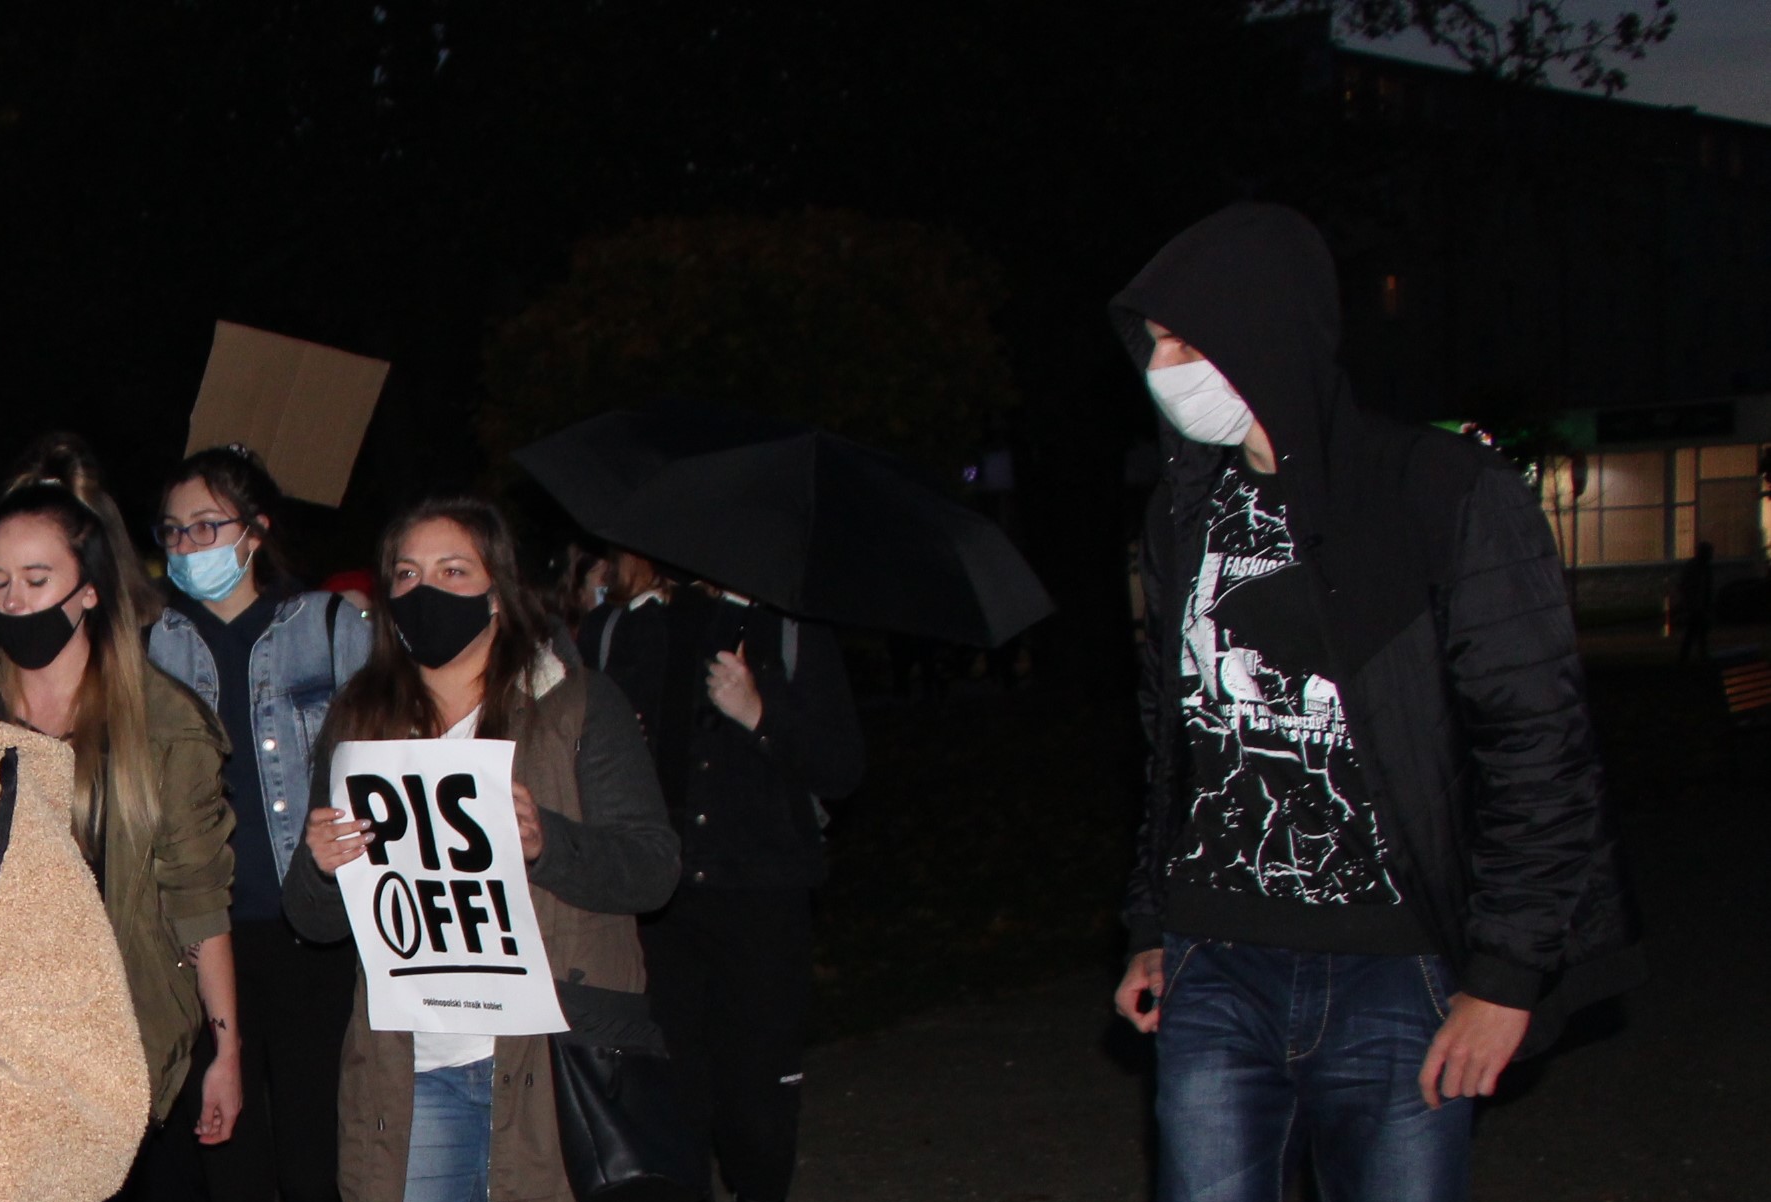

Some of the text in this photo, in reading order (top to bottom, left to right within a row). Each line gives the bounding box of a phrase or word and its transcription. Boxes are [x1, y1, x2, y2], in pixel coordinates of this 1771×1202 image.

[1222, 556, 1286, 577] FASHIO
[345, 773, 492, 872] PIS
[373, 871, 518, 959] OFF!
